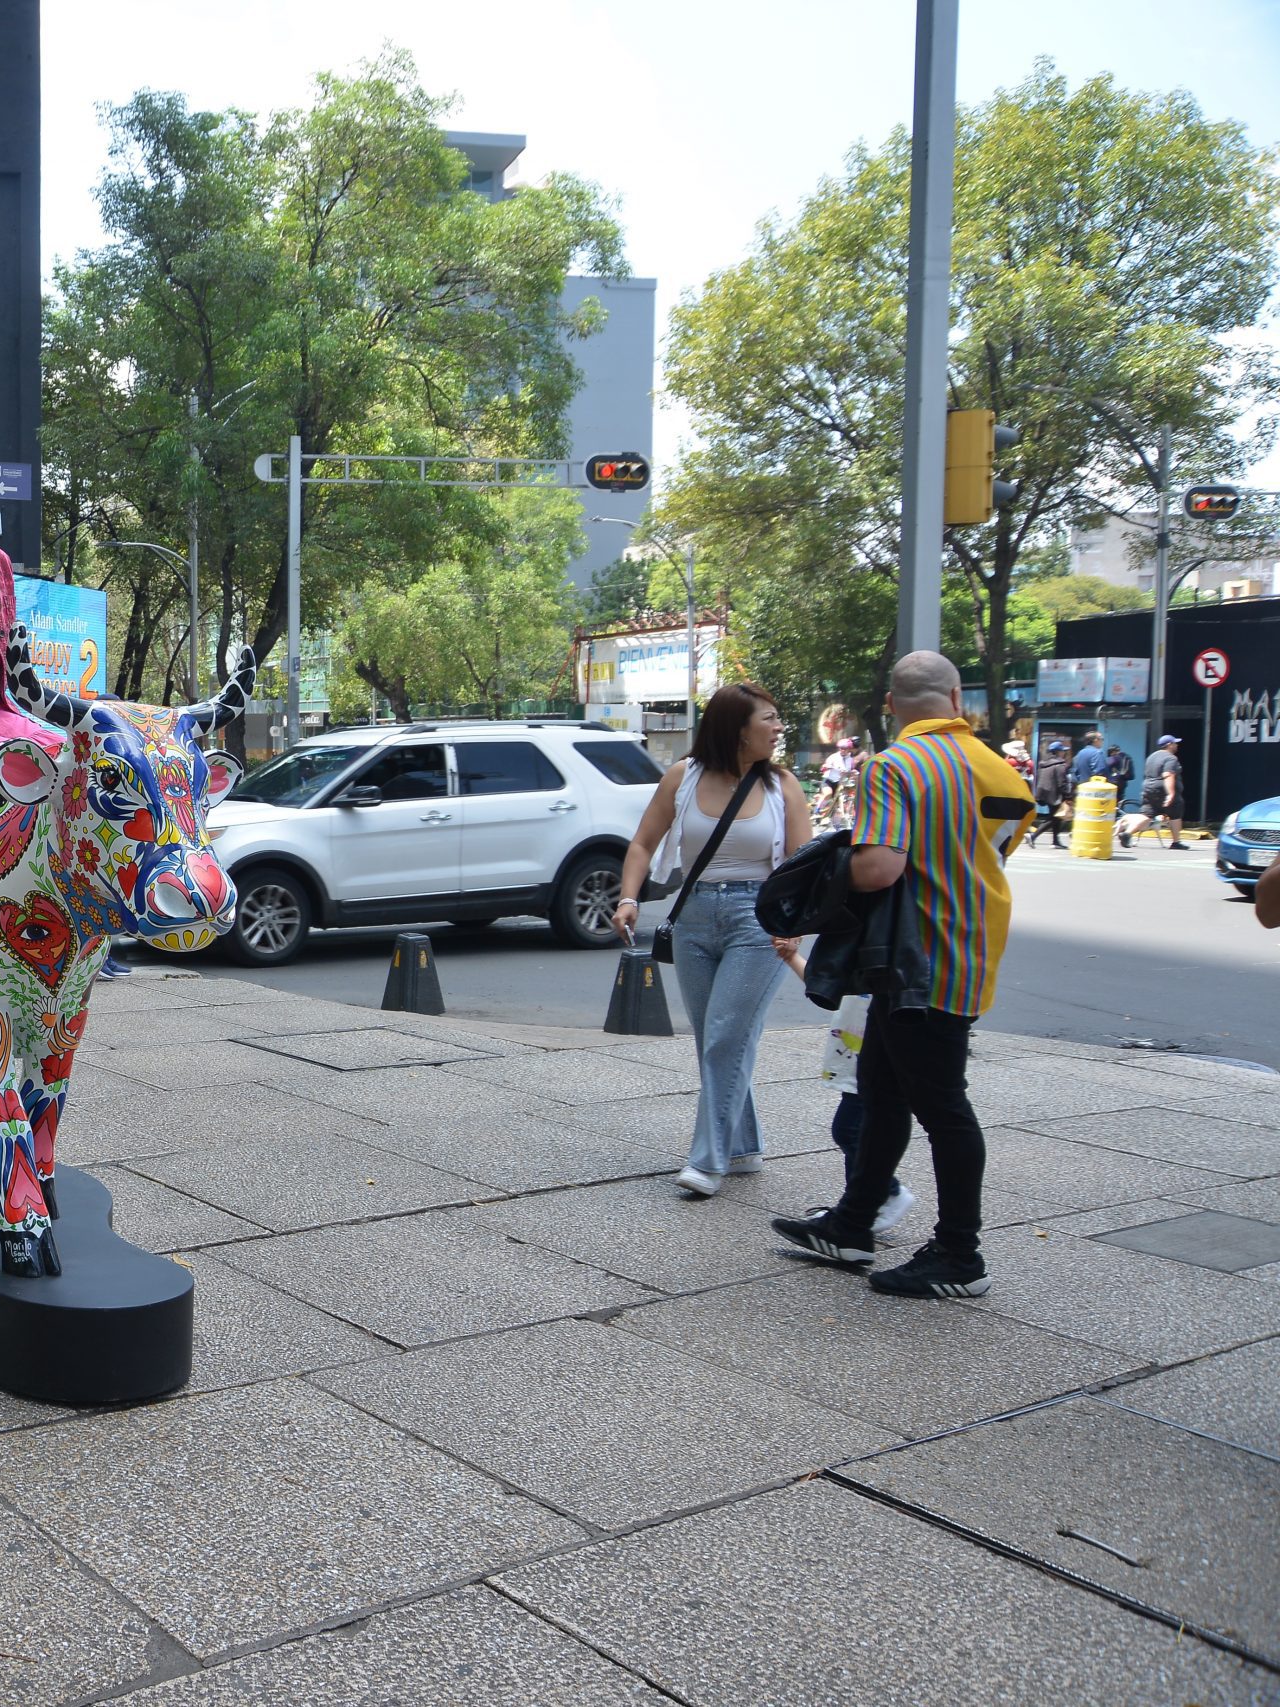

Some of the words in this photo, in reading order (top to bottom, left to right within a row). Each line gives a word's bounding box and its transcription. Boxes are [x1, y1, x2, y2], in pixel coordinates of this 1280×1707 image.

[30, 609, 54, 630] Adam
[56, 614, 88, 634] Sandler
[79, 638, 99, 700] 2
[1229, 719, 1258, 742] DE
